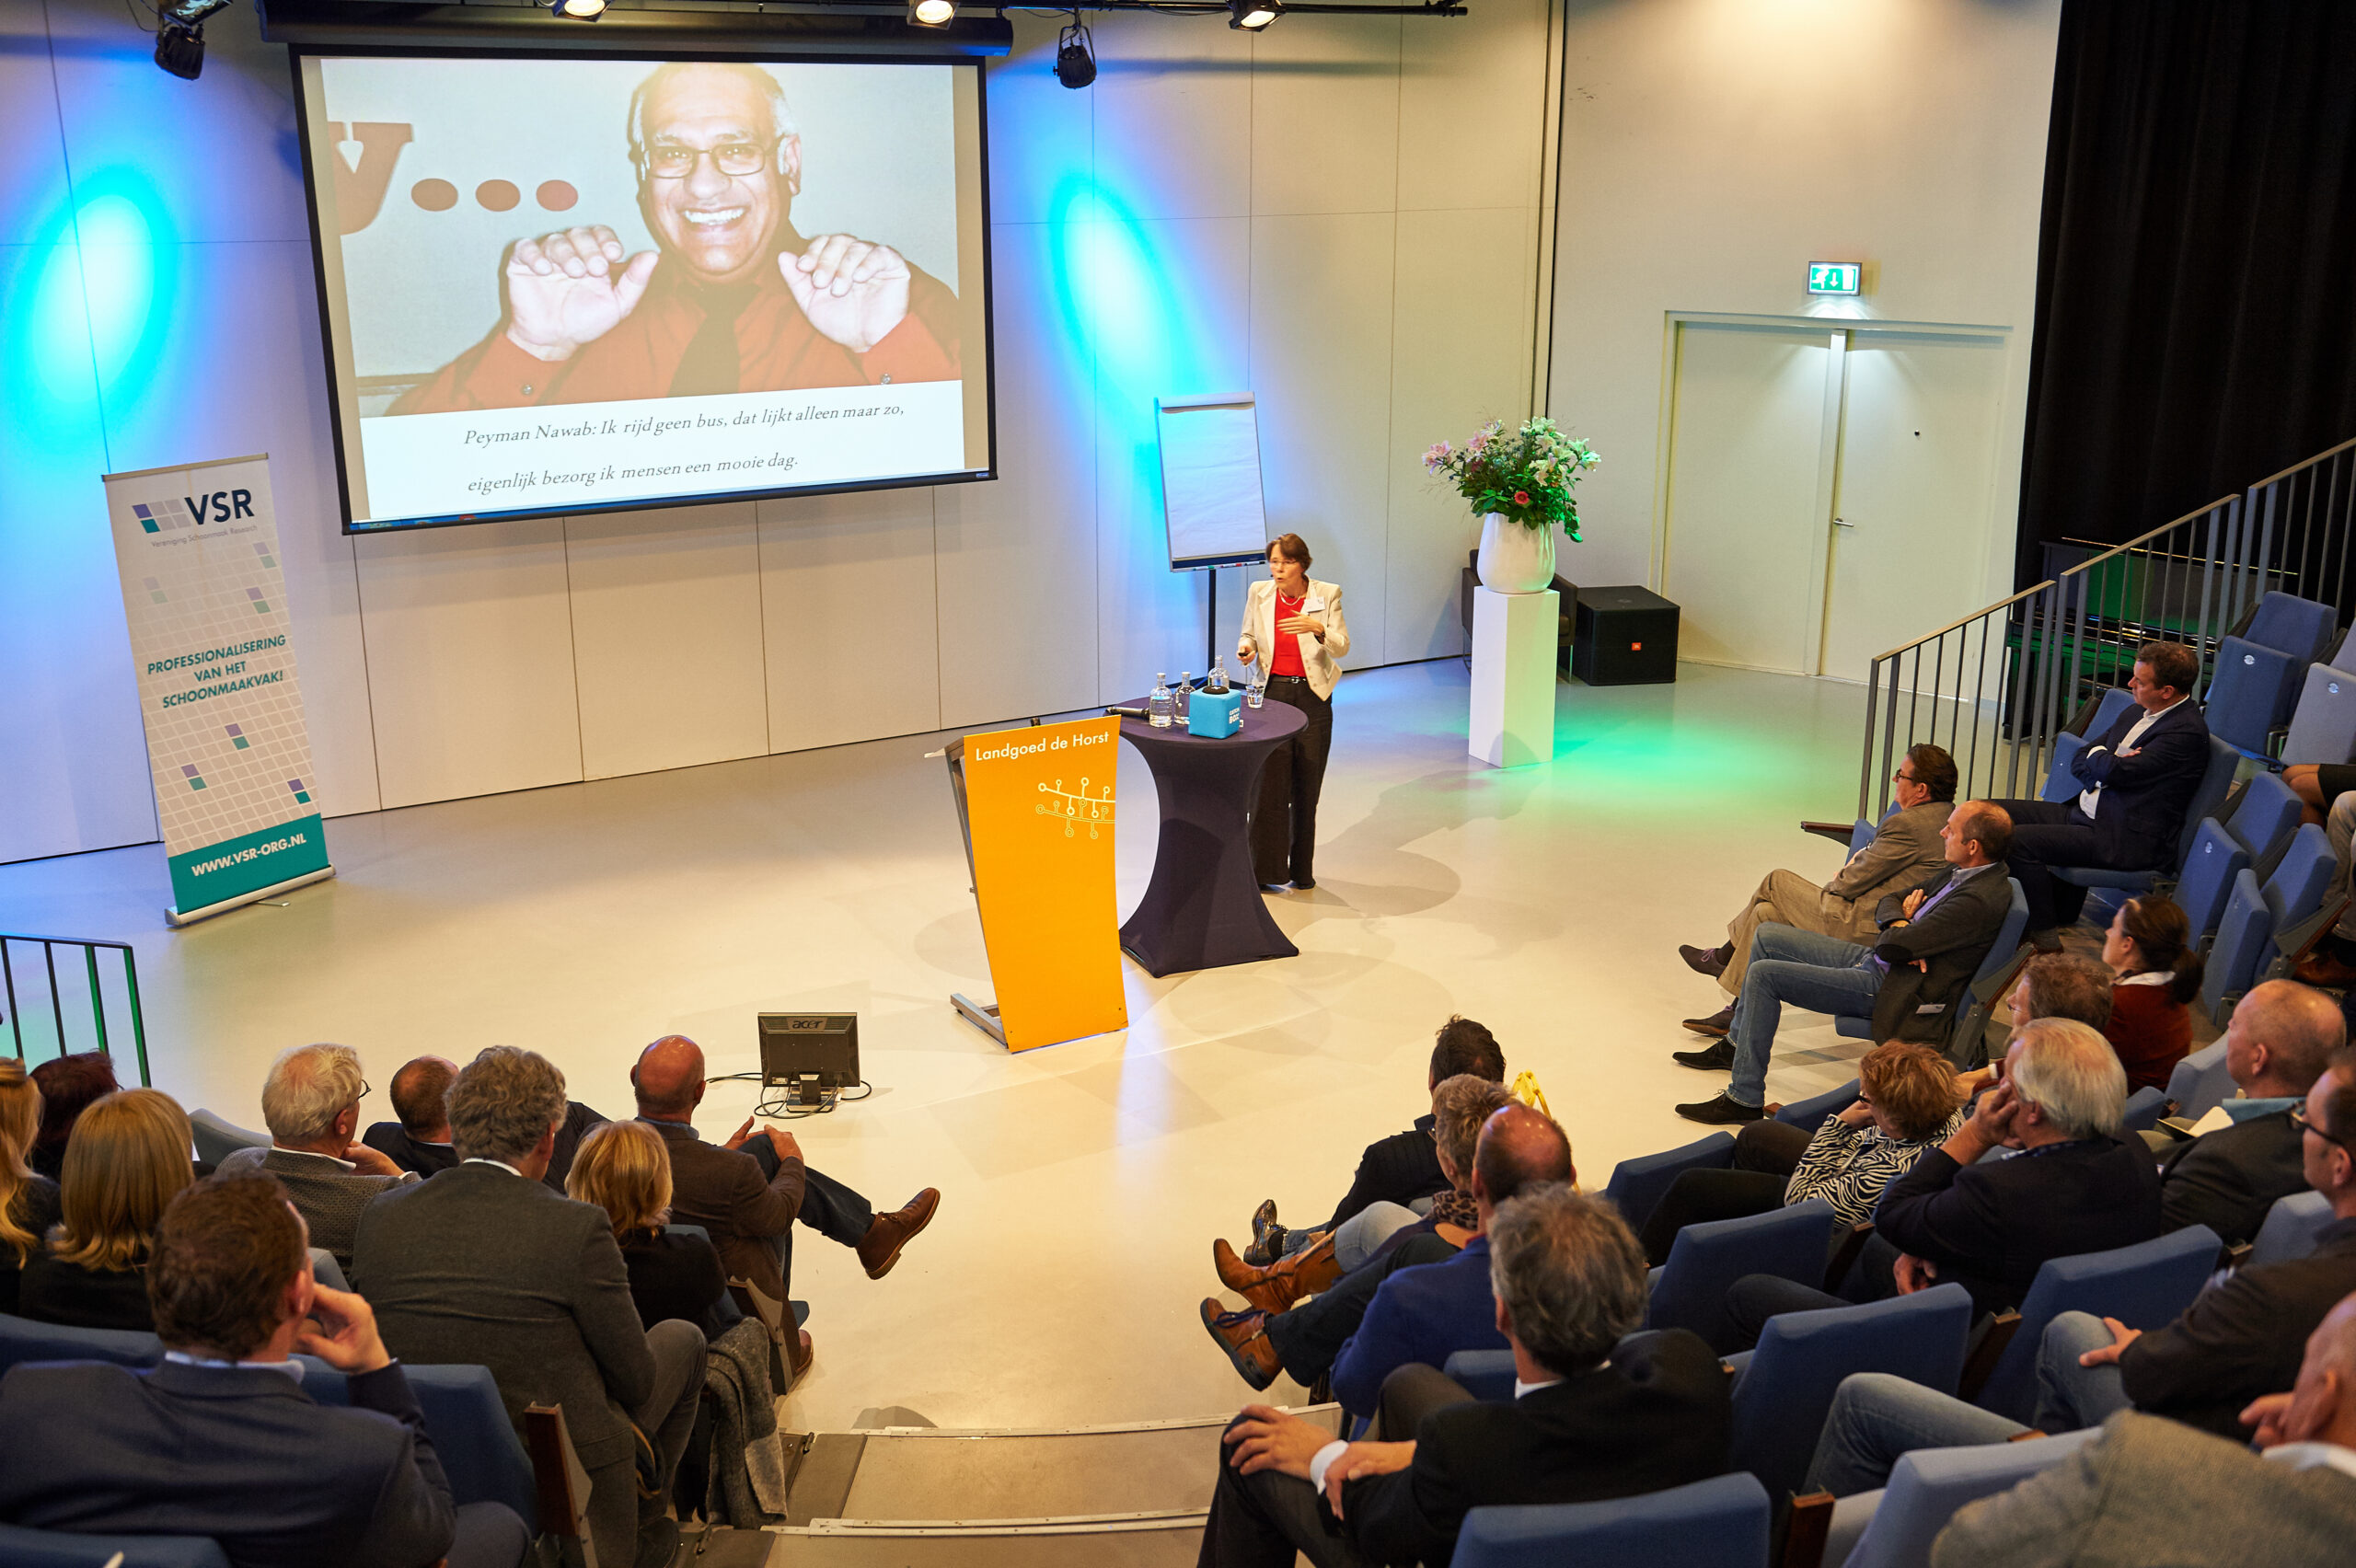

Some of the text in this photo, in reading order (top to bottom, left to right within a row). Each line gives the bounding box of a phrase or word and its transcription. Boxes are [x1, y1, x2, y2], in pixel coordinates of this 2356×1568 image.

[464, 404, 905, 449] Peyman Nawab: Ik rijd geen bus, dat lijkt alleen maar zo,
[468, 452, 799, 495] eigenlijk bezorg ik mensen een mooie dag.
[184, 489, 255, 525] VSR
[151, 536, 188, 548] Vereniging
[230, 525, 258, 535] Research
[147, 635, 286, 674] PROFESSIONALISERING
[193, 660, 247, 683] VAN HET
[162, 670, 283, 709] SCHOONMAAKVAK!
[976, 731, 1110, 761] Landgoed de Horst
[191, 833, 306, 876] WWW.VSR-ORG.NL
[792, 1020, 824, 1029] acer
